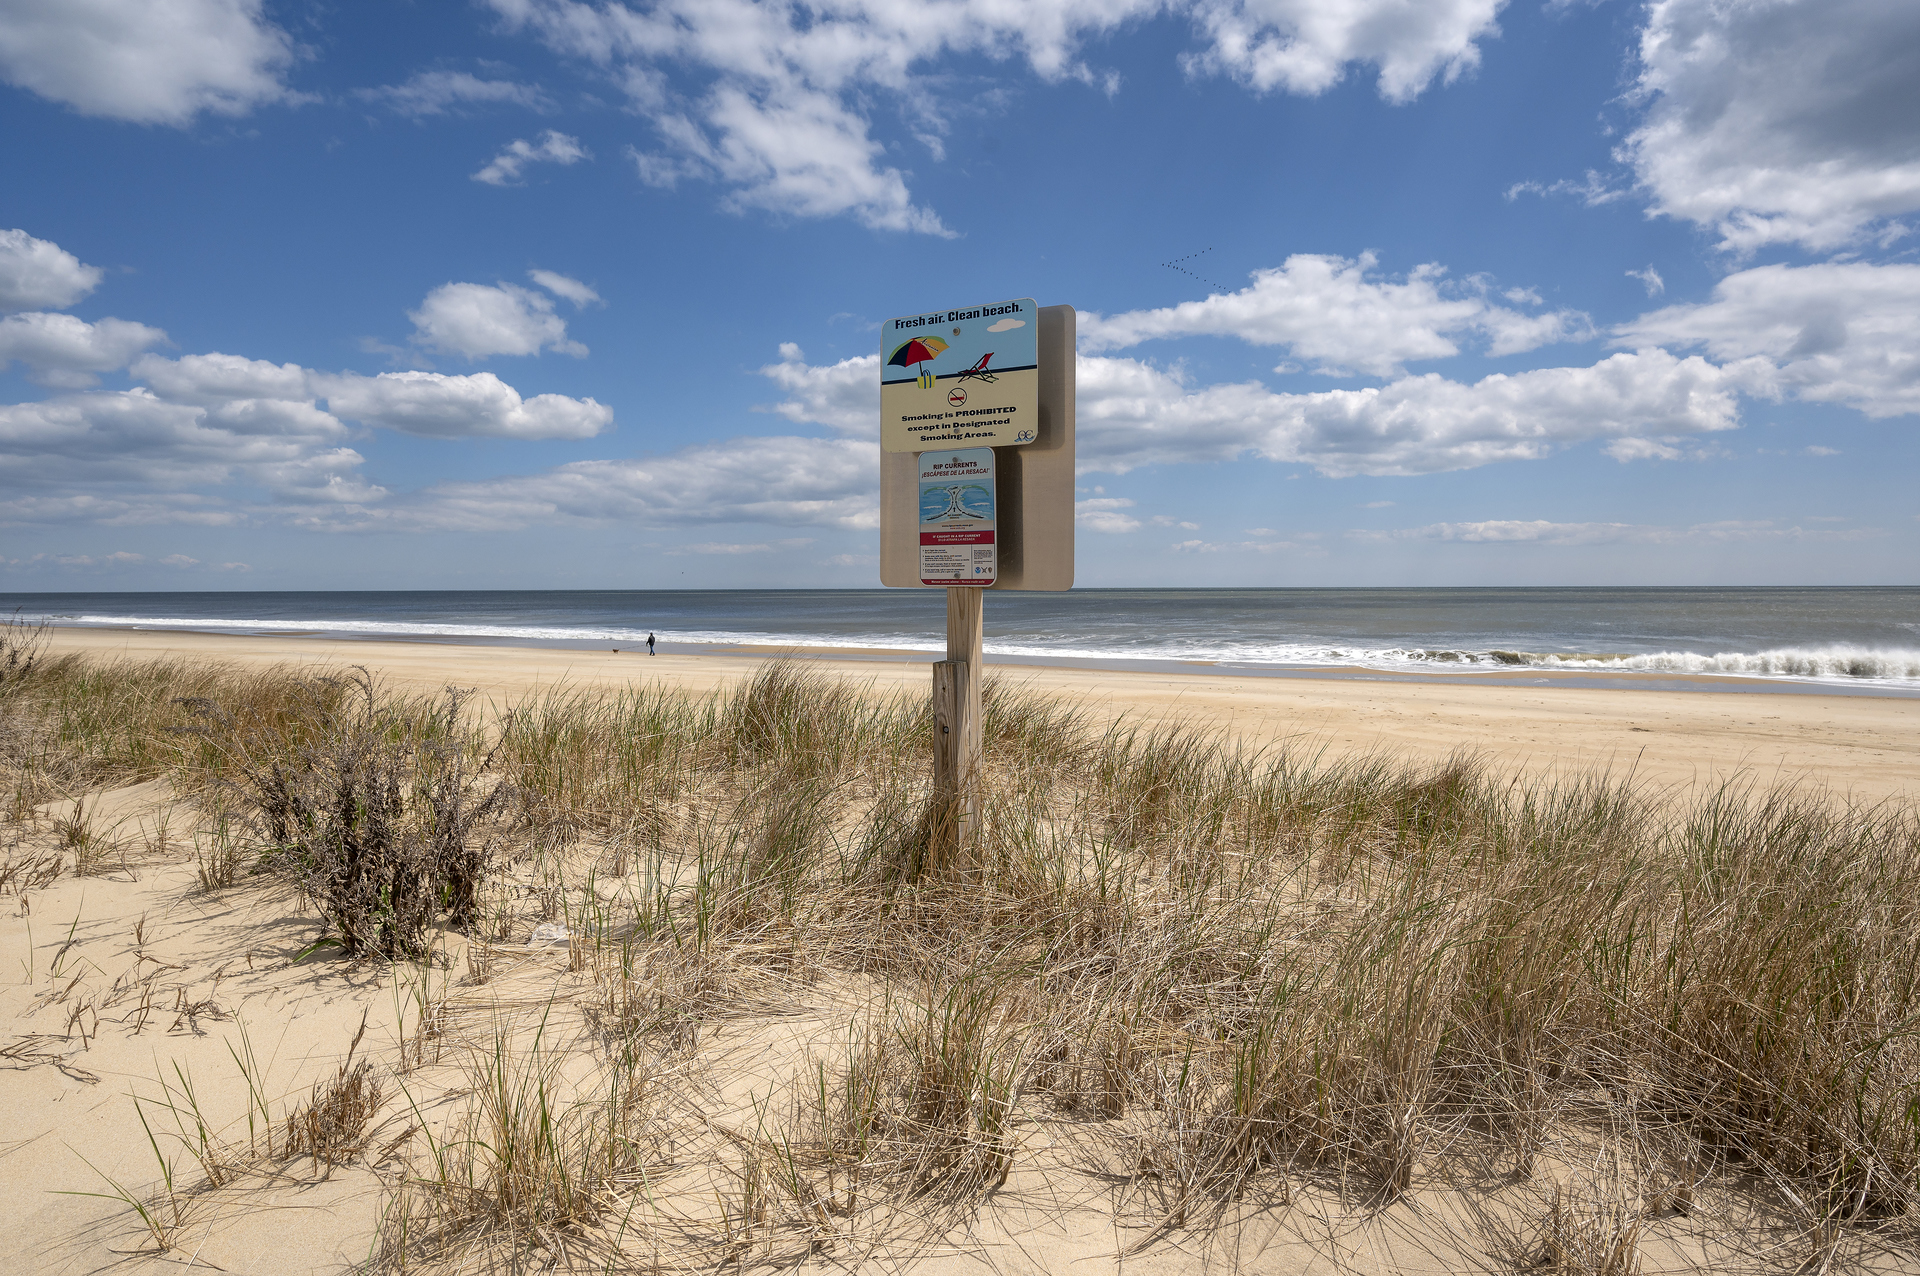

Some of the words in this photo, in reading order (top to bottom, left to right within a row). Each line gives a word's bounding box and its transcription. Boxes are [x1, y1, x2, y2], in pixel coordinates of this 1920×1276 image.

[895, 316, 926, 330] Fresh
[928, 314, 946, 324] air.
[948, 310, 980, 322] Clean
[982, 302, 1023, 317] beach.
[901, 413, 944, 422] Smoking
[955, 406, 1017, 417] PROHIBITED
[907, 424, 940, 432] except
[952, 418, 1010, 428] Designated
[920, 433, 963, 441] Smoking
